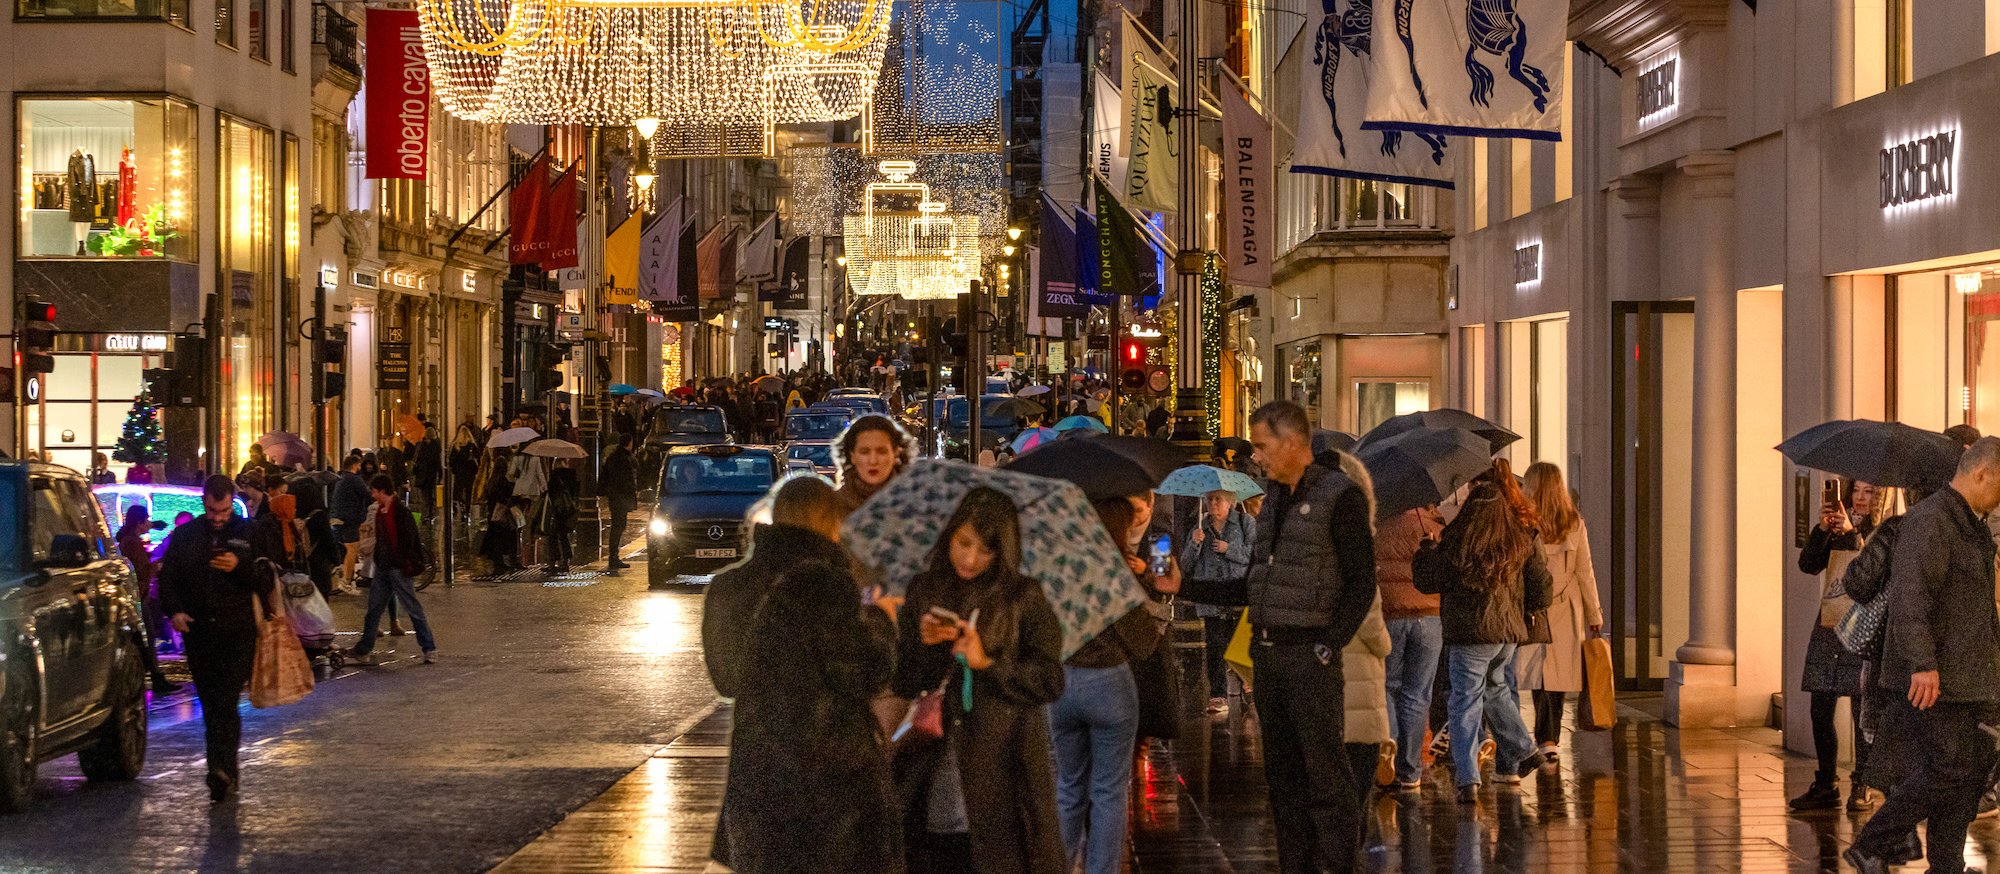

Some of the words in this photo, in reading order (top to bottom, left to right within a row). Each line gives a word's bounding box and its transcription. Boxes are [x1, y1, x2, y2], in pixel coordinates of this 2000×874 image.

[400, 26, 427, 95] cavalli
[397, 99, 426, 175] roberto
[1129, 83, 1158, 201] AQUAZZURA
[1879, 129, 1957, 209] BURBERRY
[1099, 194, 1112, 287] LONGCHAMP
[1237, 137, 1258, 266] BALENCIAGA
[512, 241, 551, 252] GUCCI
